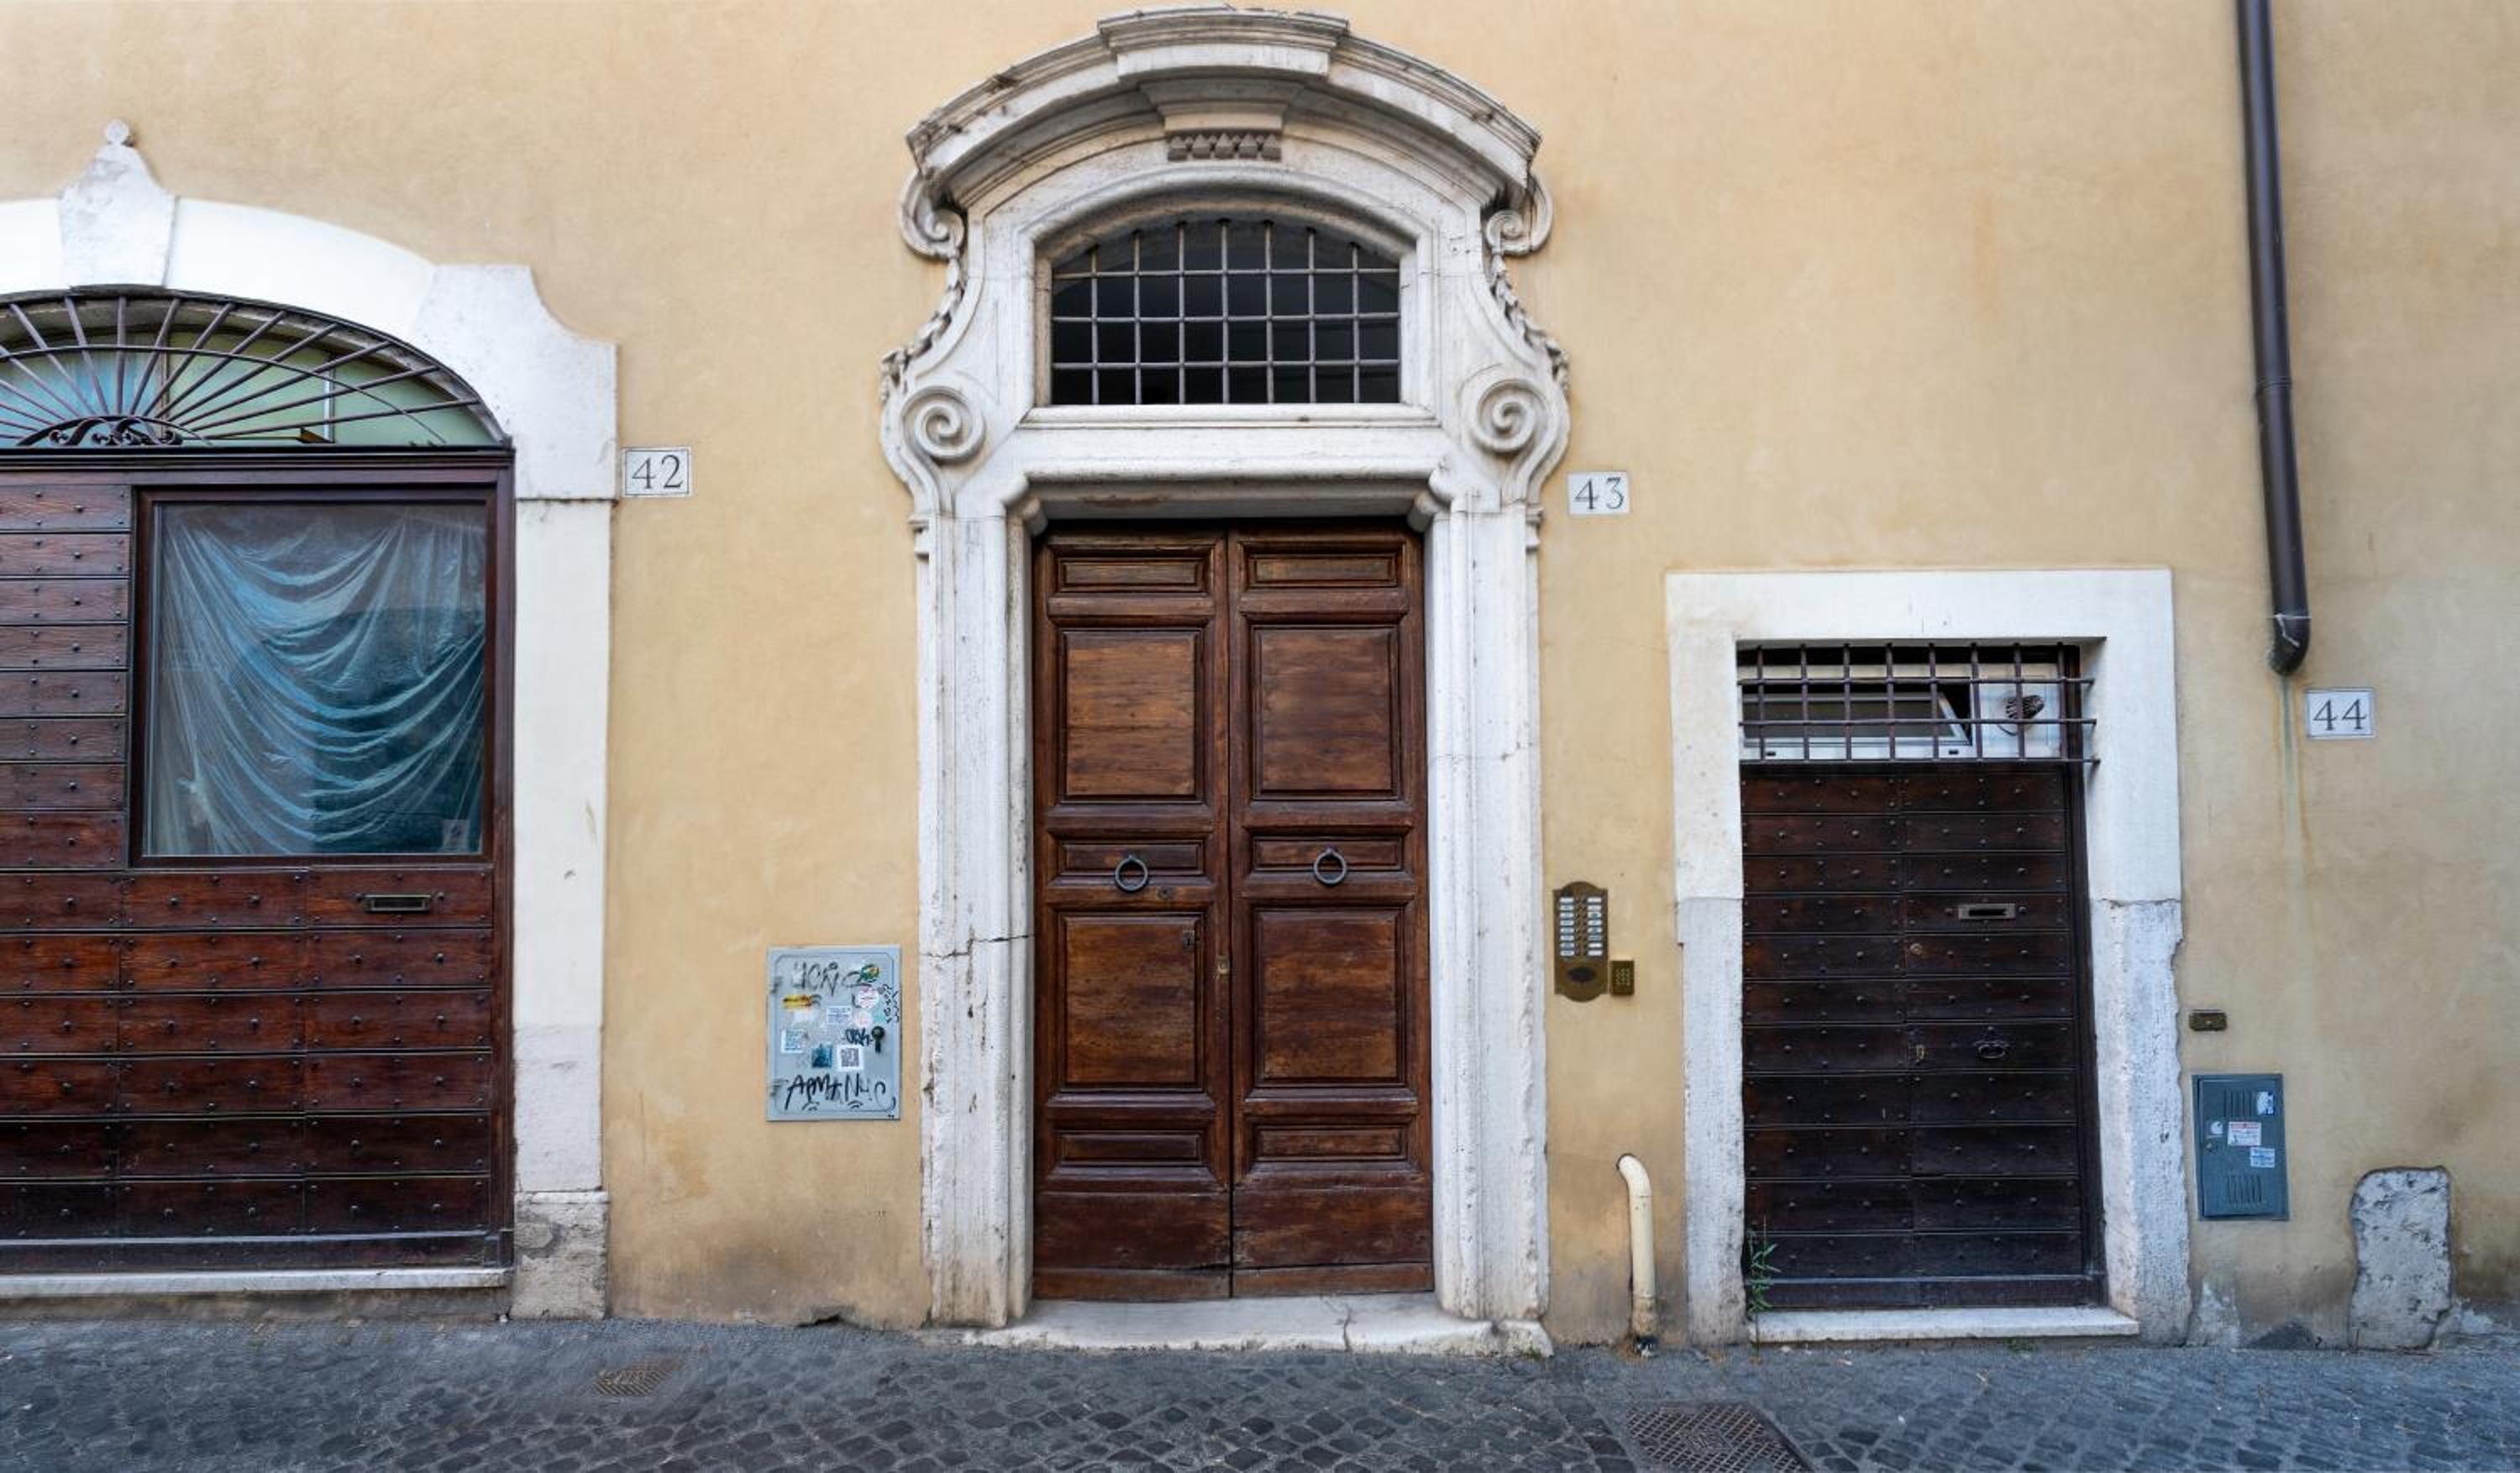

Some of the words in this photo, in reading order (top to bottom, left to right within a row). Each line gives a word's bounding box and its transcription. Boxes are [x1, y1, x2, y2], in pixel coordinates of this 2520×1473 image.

[632, 454, 684, 489] 42
[1573, 477, 1624, 510] 43
[2313, 699, 2367, 731] 44
